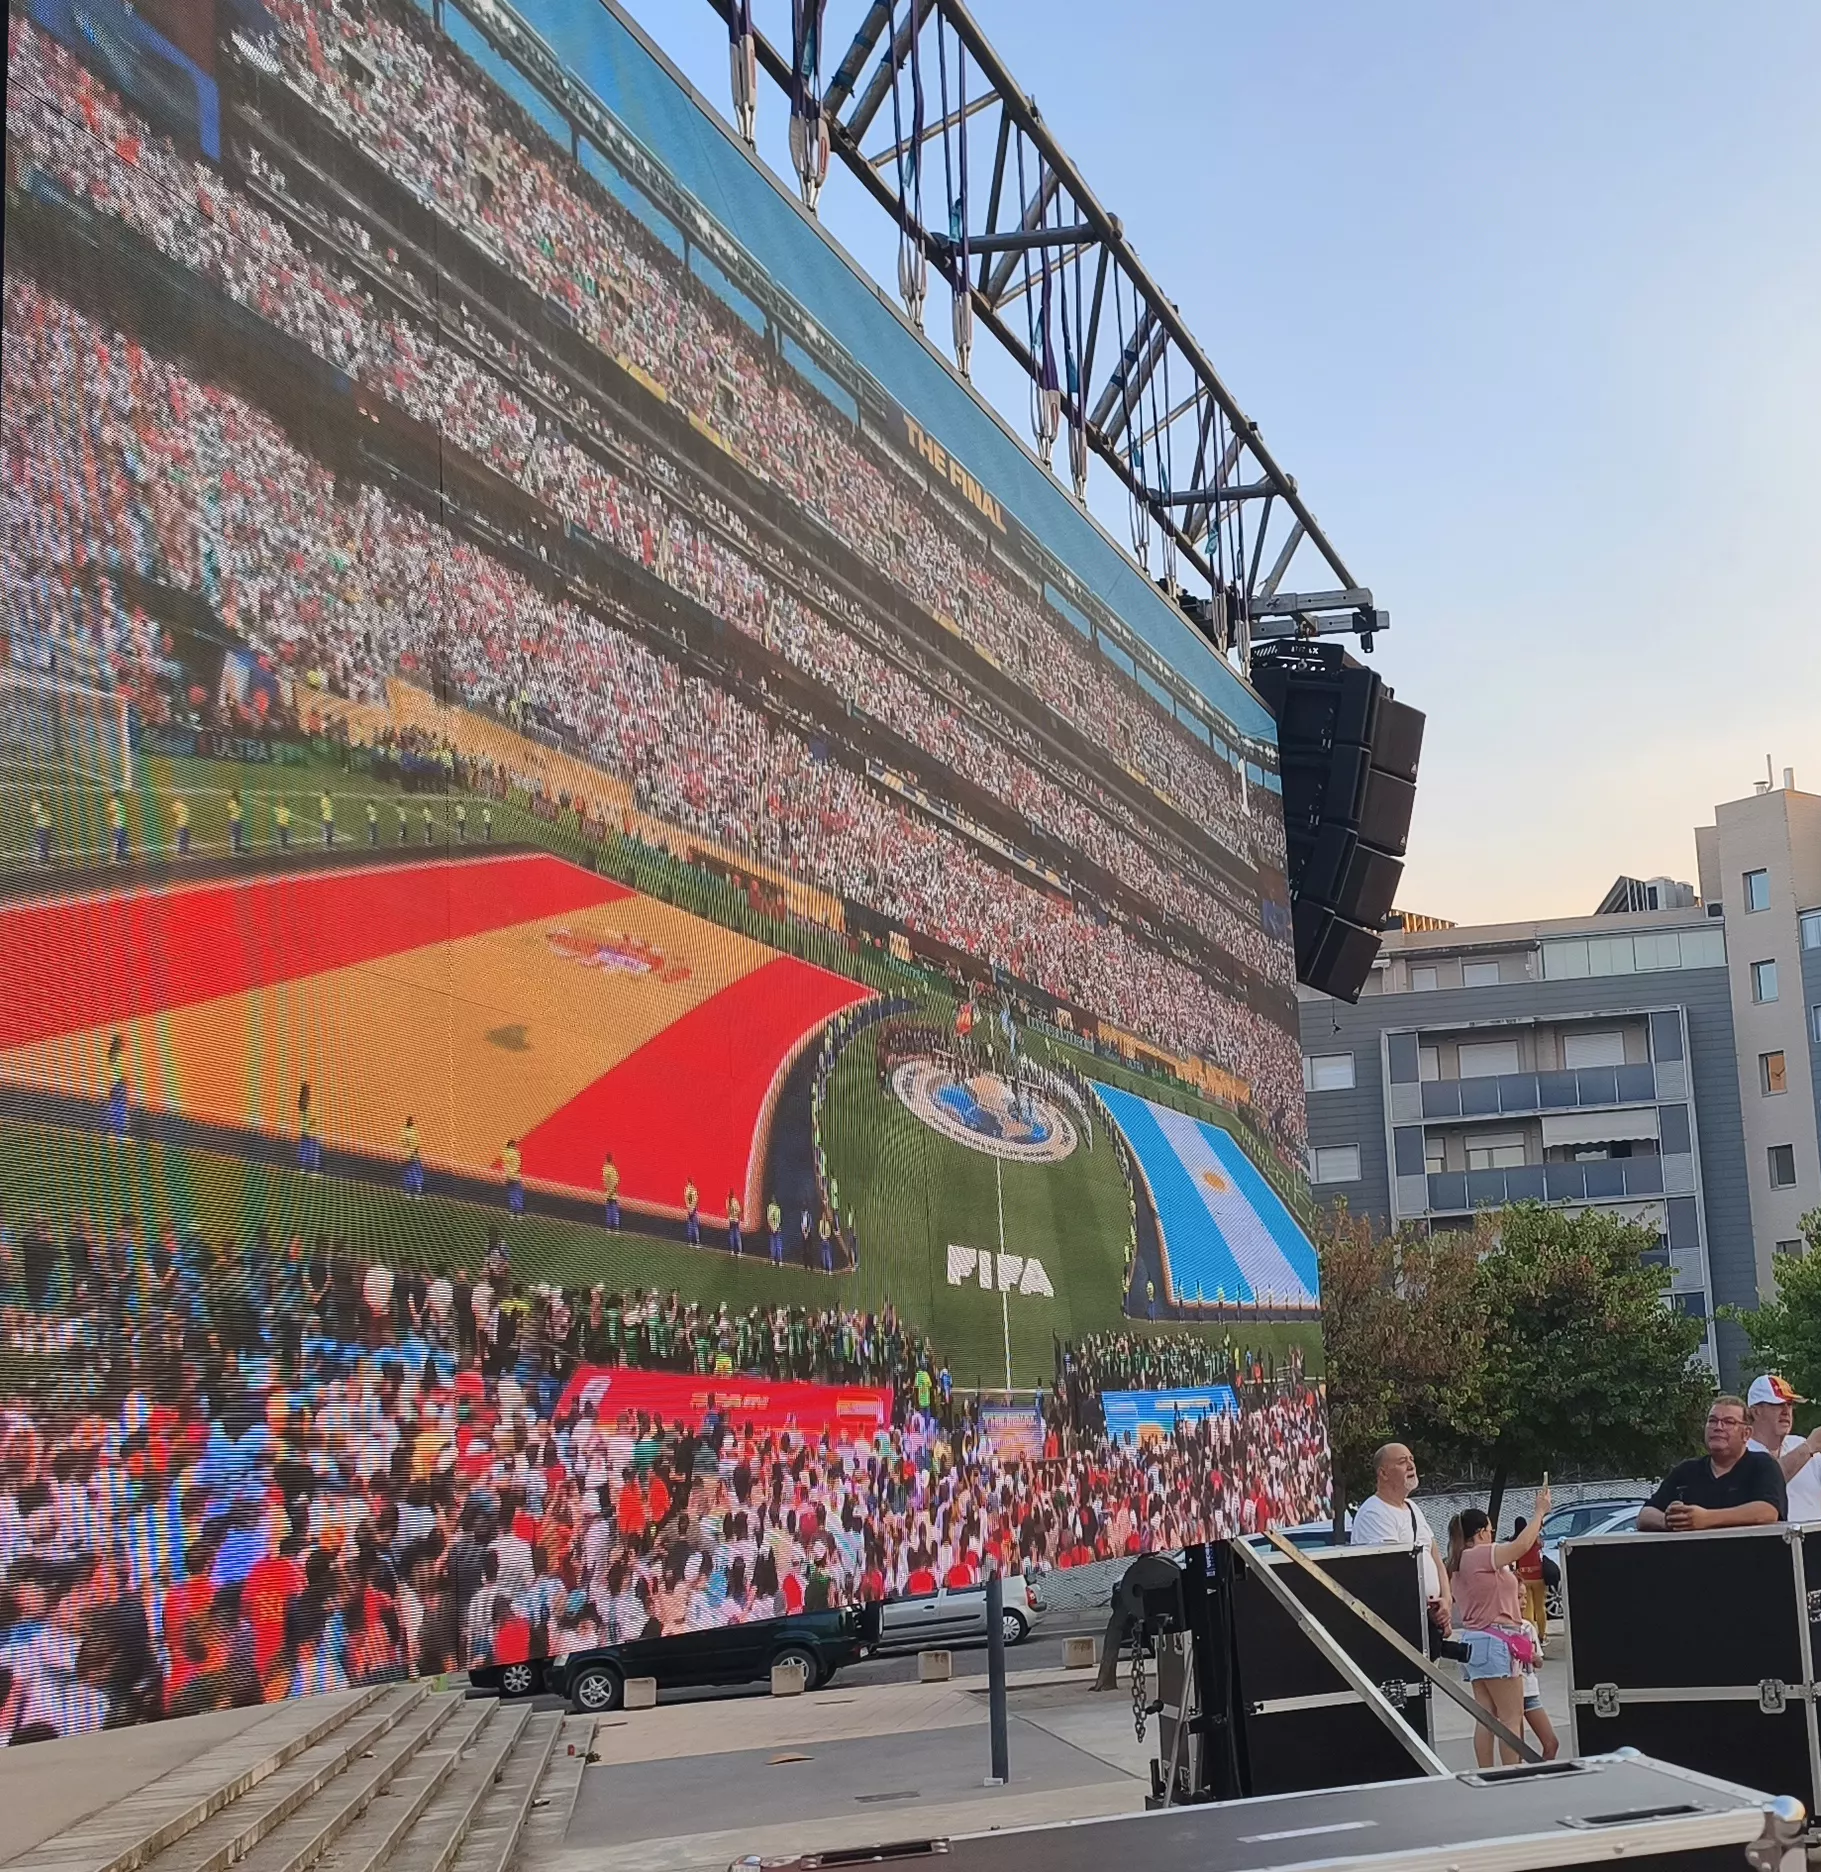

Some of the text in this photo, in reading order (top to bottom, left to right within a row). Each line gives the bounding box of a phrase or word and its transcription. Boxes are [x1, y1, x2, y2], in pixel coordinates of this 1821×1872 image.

[903, 413, 1007, 535] THE FINAL
[947, 1244, 1055, 1298] FIFA
